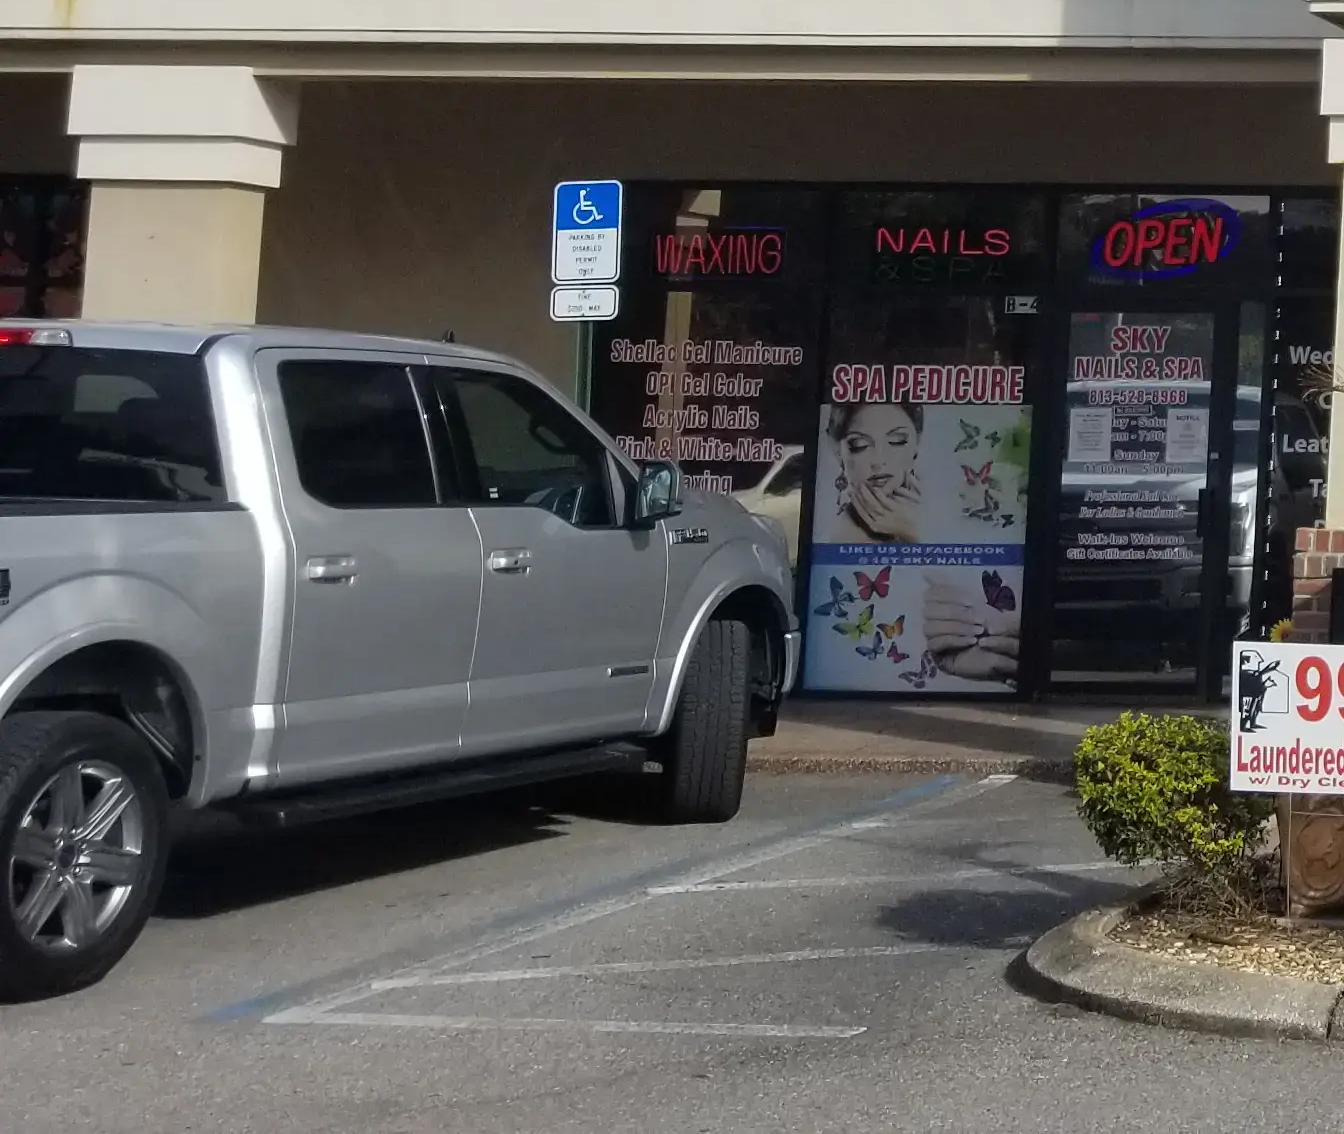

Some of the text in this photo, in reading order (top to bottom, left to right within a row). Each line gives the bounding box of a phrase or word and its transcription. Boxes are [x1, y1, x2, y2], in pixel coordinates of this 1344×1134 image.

[655, 234, 783, 275] WAXING
[876, 227, 1010, 256] NAILS
[1104, 217, 1223, 267] OPEN
[575, 256, 597, 264] PERMIT
[610, 338, 803, 365] Shellac Gel Manicure
[1111, 325, 1171, 353] SKY
[1074, 356, 1204, 381] NAILS & SPA
[646, 371, 763, 397] OPI Gel Color
[832, 364, 1025, 404] SPA PEDICURE
[642, 404, 760, 433] Acrylic Nails
[616, 436, 784, 463] Pink & White Nails
[1114, 449, 1160, 463] Sunday
[682, 470, 733, 496] axing
[838, 546, 1005, 555] LIKE US ON FACEBOOK
[1130, 533, 1185, 545] Welcome
[937, 557, 981, 565] NAILS
[1249, 775, 1272, 786] w/
[1278, 776, 1311, 789] Dry
